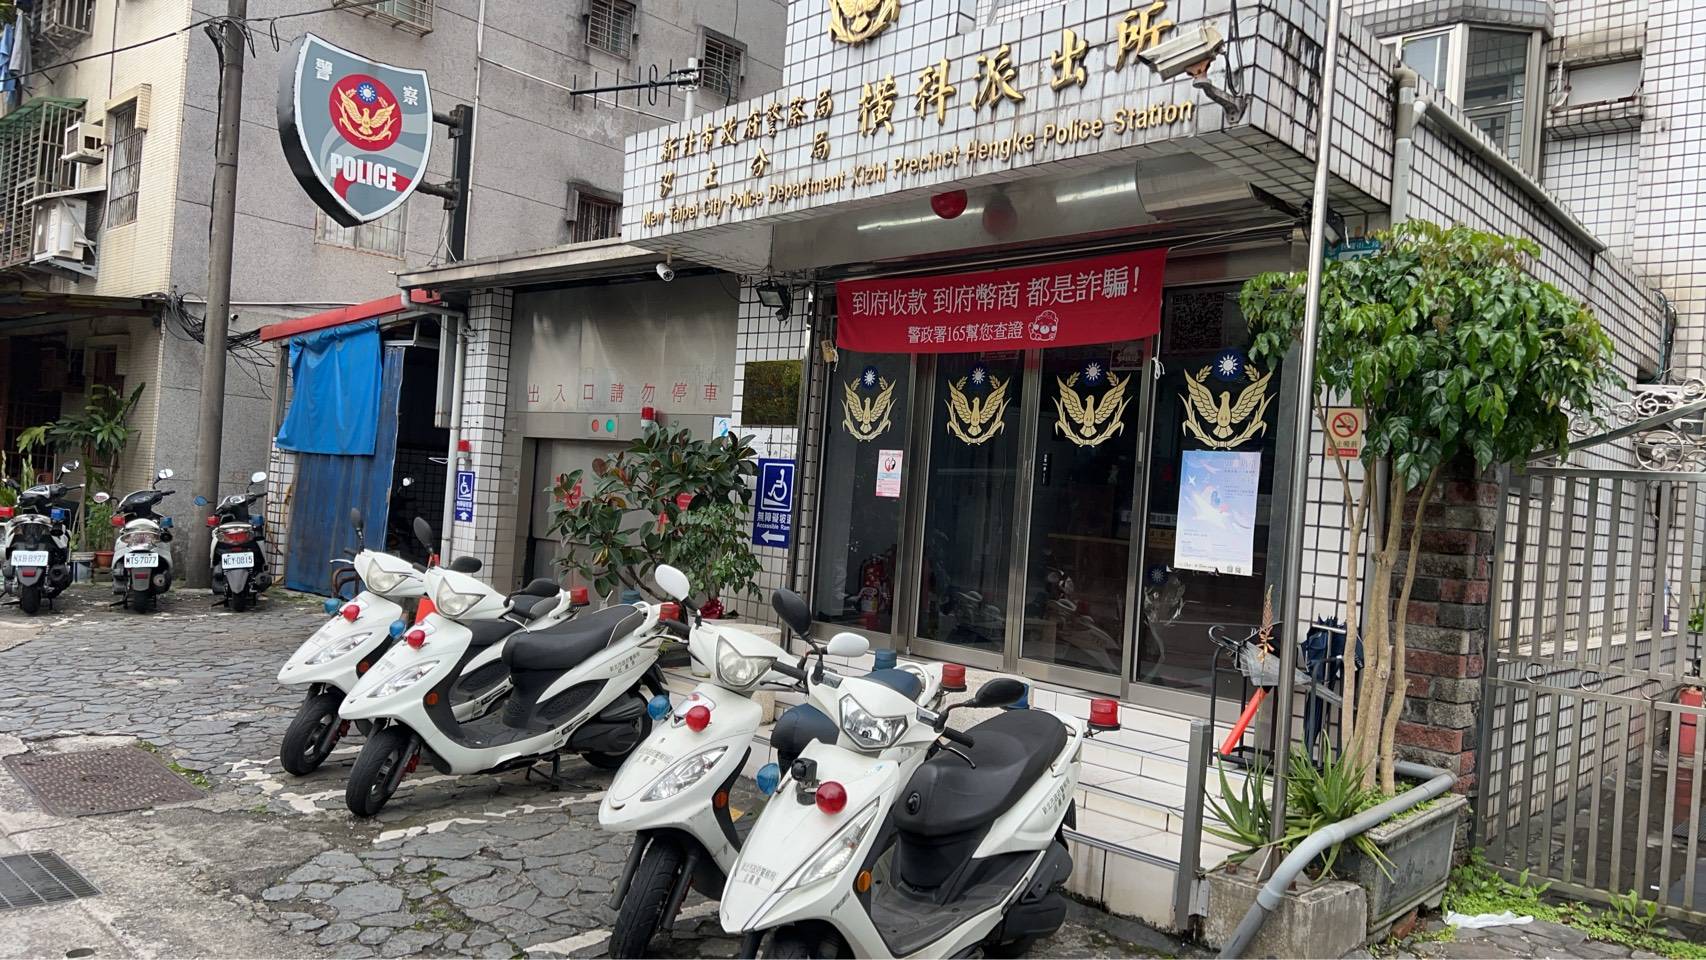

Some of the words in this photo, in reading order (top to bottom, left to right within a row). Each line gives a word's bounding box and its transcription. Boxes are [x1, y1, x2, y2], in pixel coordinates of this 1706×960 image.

[315, 58, 333, 81] 警
[402, 85, 419, 106] 察
[330, 152, 397, 192] POLICE
[642, 211, 665, 228] New
[669, 202, 699, 224] Taipei
[703, 198, 725, 218] City
[729, 189, 763, 210] Police
[768, 171, 846, 206] Department
[851, 160, 887, 188] Xizhi
[893, 144, 960, 179] Precinct
[966, 131, 1035, 163] Hengke
[1043, 117, 1104, 149] Police
[1113, 99, 1196, 135] Station
[852, 288, 928, 316] 到府收款
[933, 281, 1021, 315] 到府幣商
[1026, 265, 1141, 307] 都是詐騙!
[907, 321, 1023, 344] 警政署165幫您查證
[527, 382, 719, 403] 出入口請勿停車
